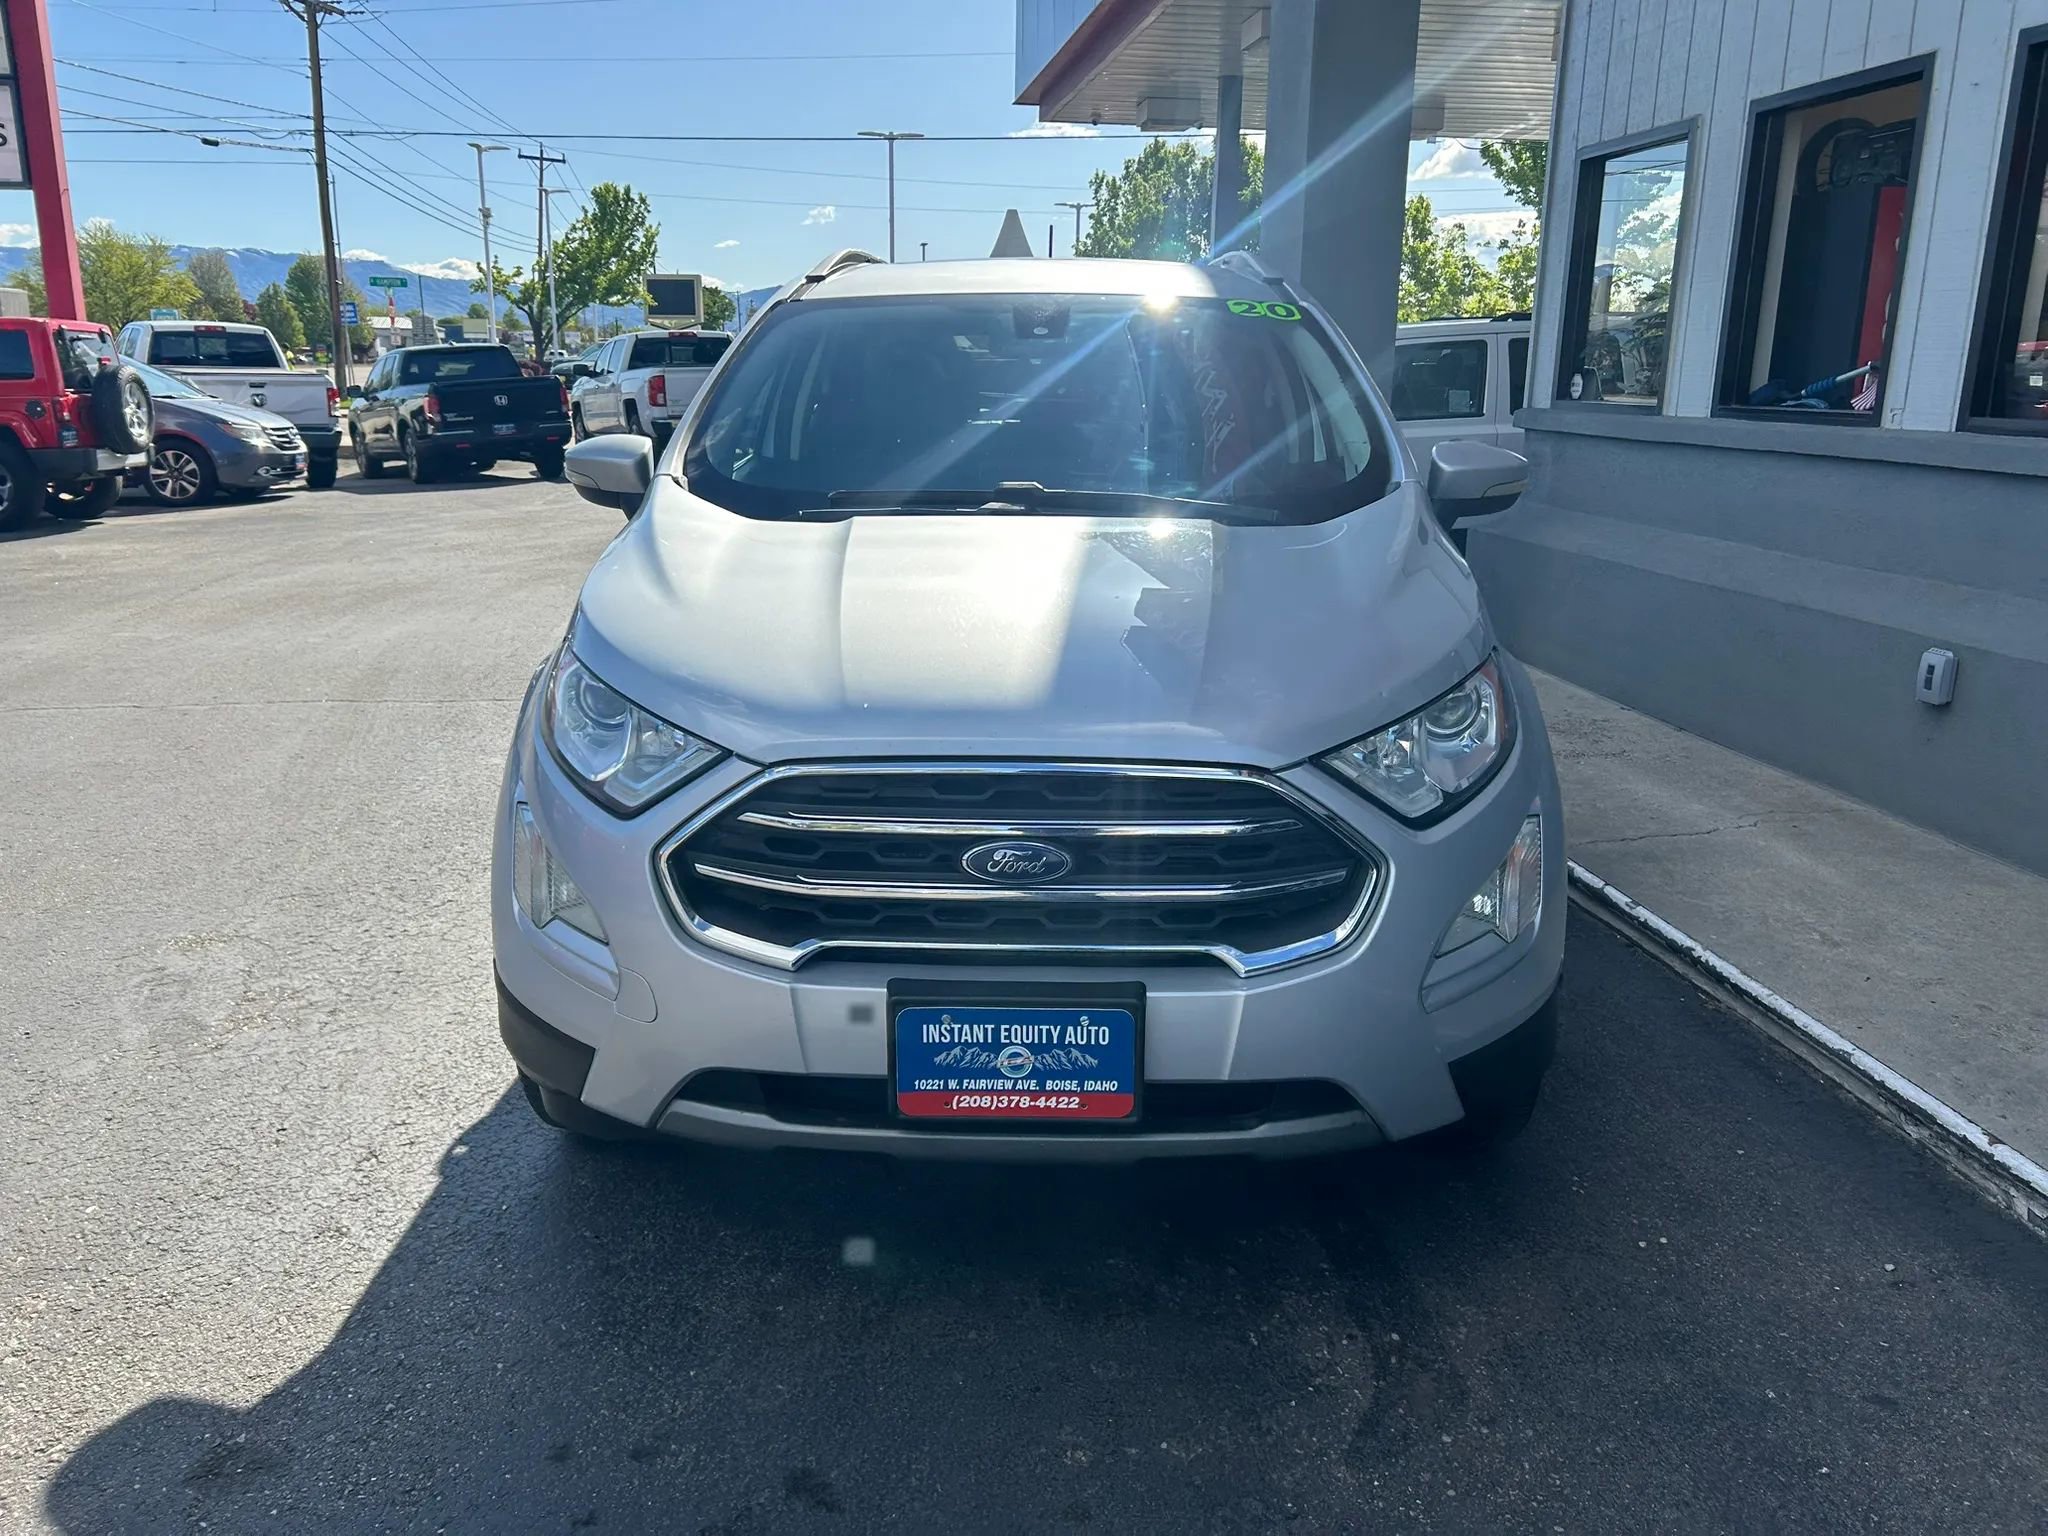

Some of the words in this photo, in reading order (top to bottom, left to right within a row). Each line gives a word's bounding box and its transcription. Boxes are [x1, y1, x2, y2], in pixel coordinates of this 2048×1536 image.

[1229, 300, 1299, 319] 20
[987, 849, 1047, 873] Ford
[922, 1024, 994, 1044] INSTANT
[1000, 1025, 1061, 1044] EQUITY
[1065, 1026, 1109, 1045] AUTO
[914, 1079, 944, 1090] 10221
[948, 1080, 960, 1090] W.
[962, 1080, 1015, 1090] FAIRVIEW
[1015, 1080, 1039, 1090] AVE.
[1045, 1080, 1081, 1092] BOISE,
[1083, 1081, 1118, 1091] IDAHO
[952, 1095, 1080, 1110] (208)378-4422
